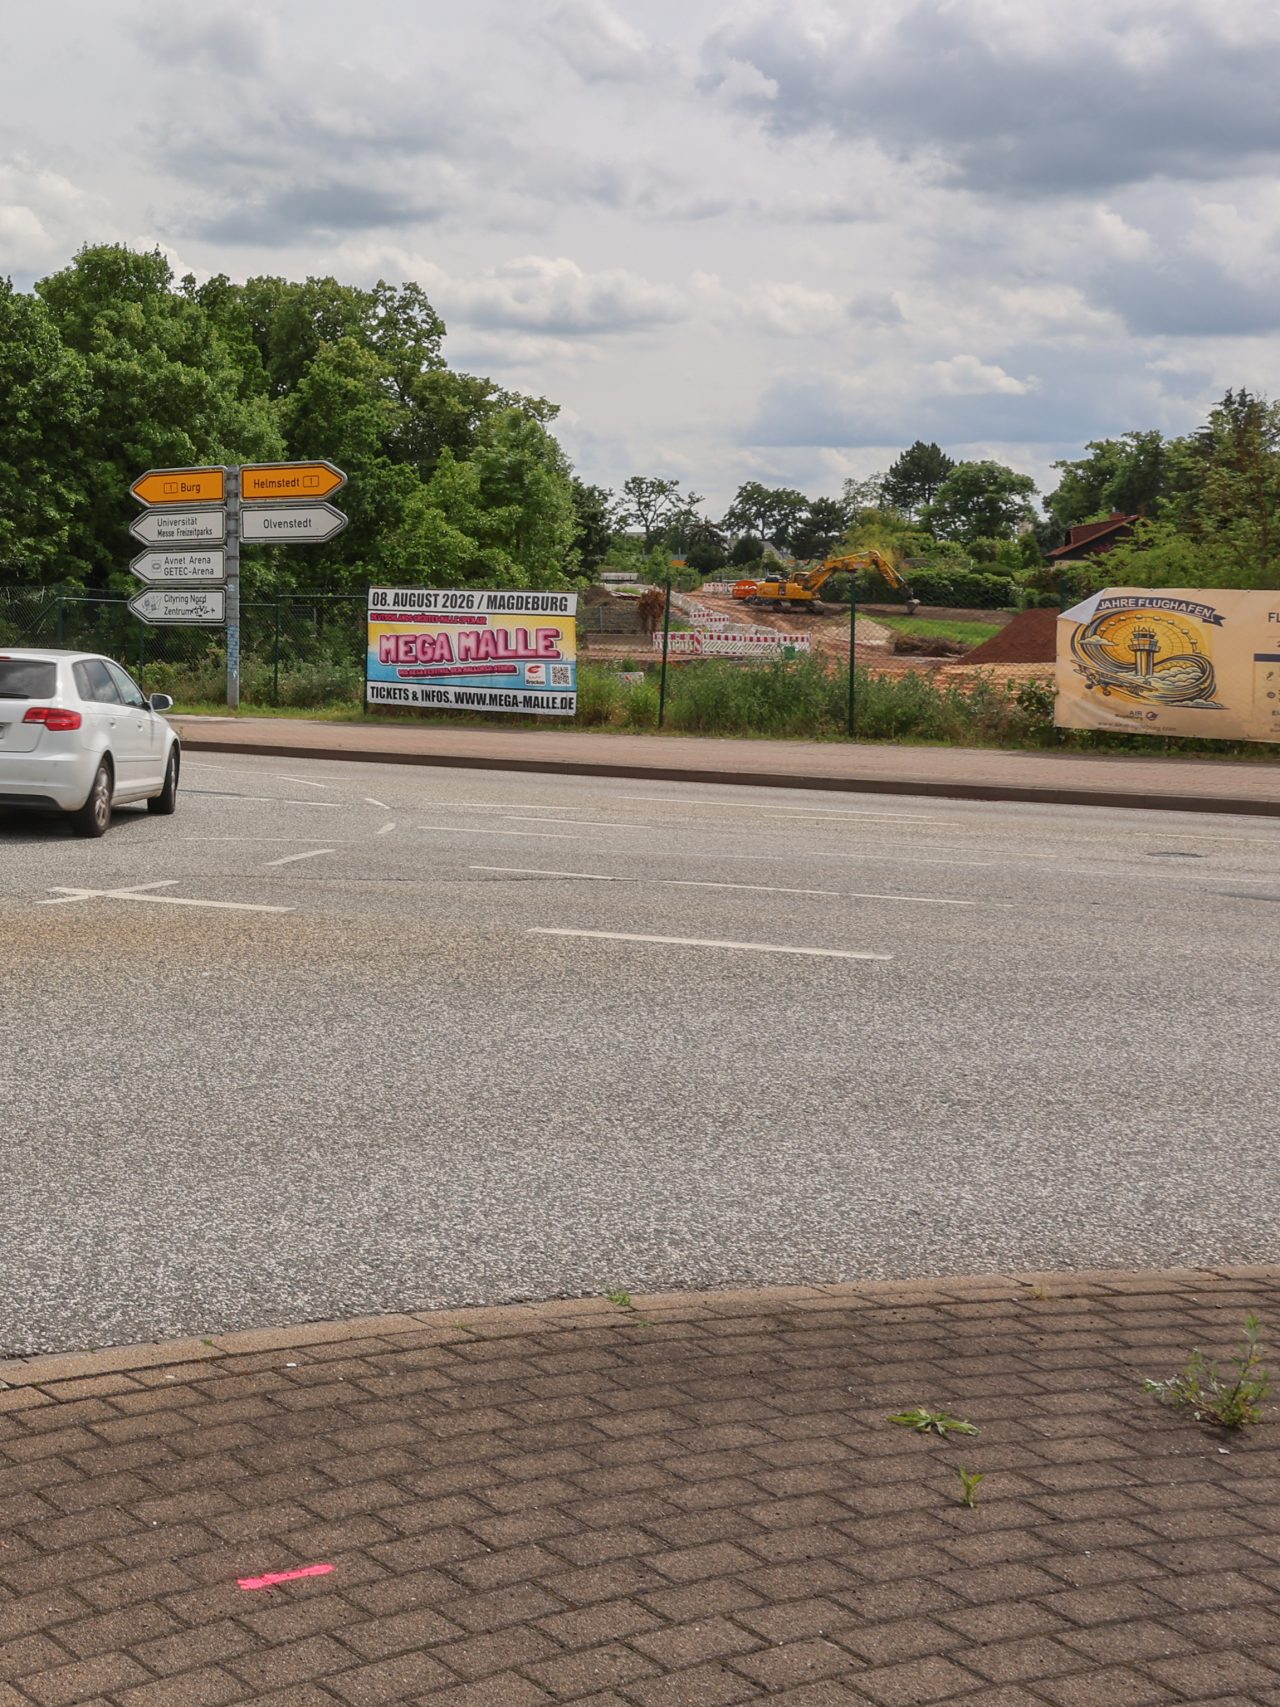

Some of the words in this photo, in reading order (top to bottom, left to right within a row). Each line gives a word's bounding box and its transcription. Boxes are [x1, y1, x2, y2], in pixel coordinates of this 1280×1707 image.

[181, 483, 201, 493] Burg
[254, 478, 300, 488] Helmstedt
[157, 518, 198, 527] Universität
[263, 519, 312, 529] Olvenstedt
[157, 529, 175, 537] Messe
[177, 527, 213, 537] Freizeitparks
[164, 557, 186, 565] Avnet
[189, 556, 211, 564] Arena
[164, 567, 214, 576] GETEC-Arena
[164, 594, 189, 605] Cityring
[372, 592, 390, 607] 08.
[392, 592, 439, 608] AUGUST
[441, 593, 475, 609] 2026
[477, 594, 484, 609] /
[486, 594, 568, 612] MAGDEBURG
[164, 607, 192, 615] Zentrum
[1099, 598, 1136, 610] JAHRE
[1137, 599, 1213, 618] FLUGHAFEN
[380, 633, 454, 664] MEGA
[458, 628, 561, 662] MALLE
[370, 686, 410, 701] TICKETS
[411, 690, 419, 701] &
[421, 689, 452, 703] INFOS.
[454, 691, 574, 710] WWW.MEGA-MALLE.DE
